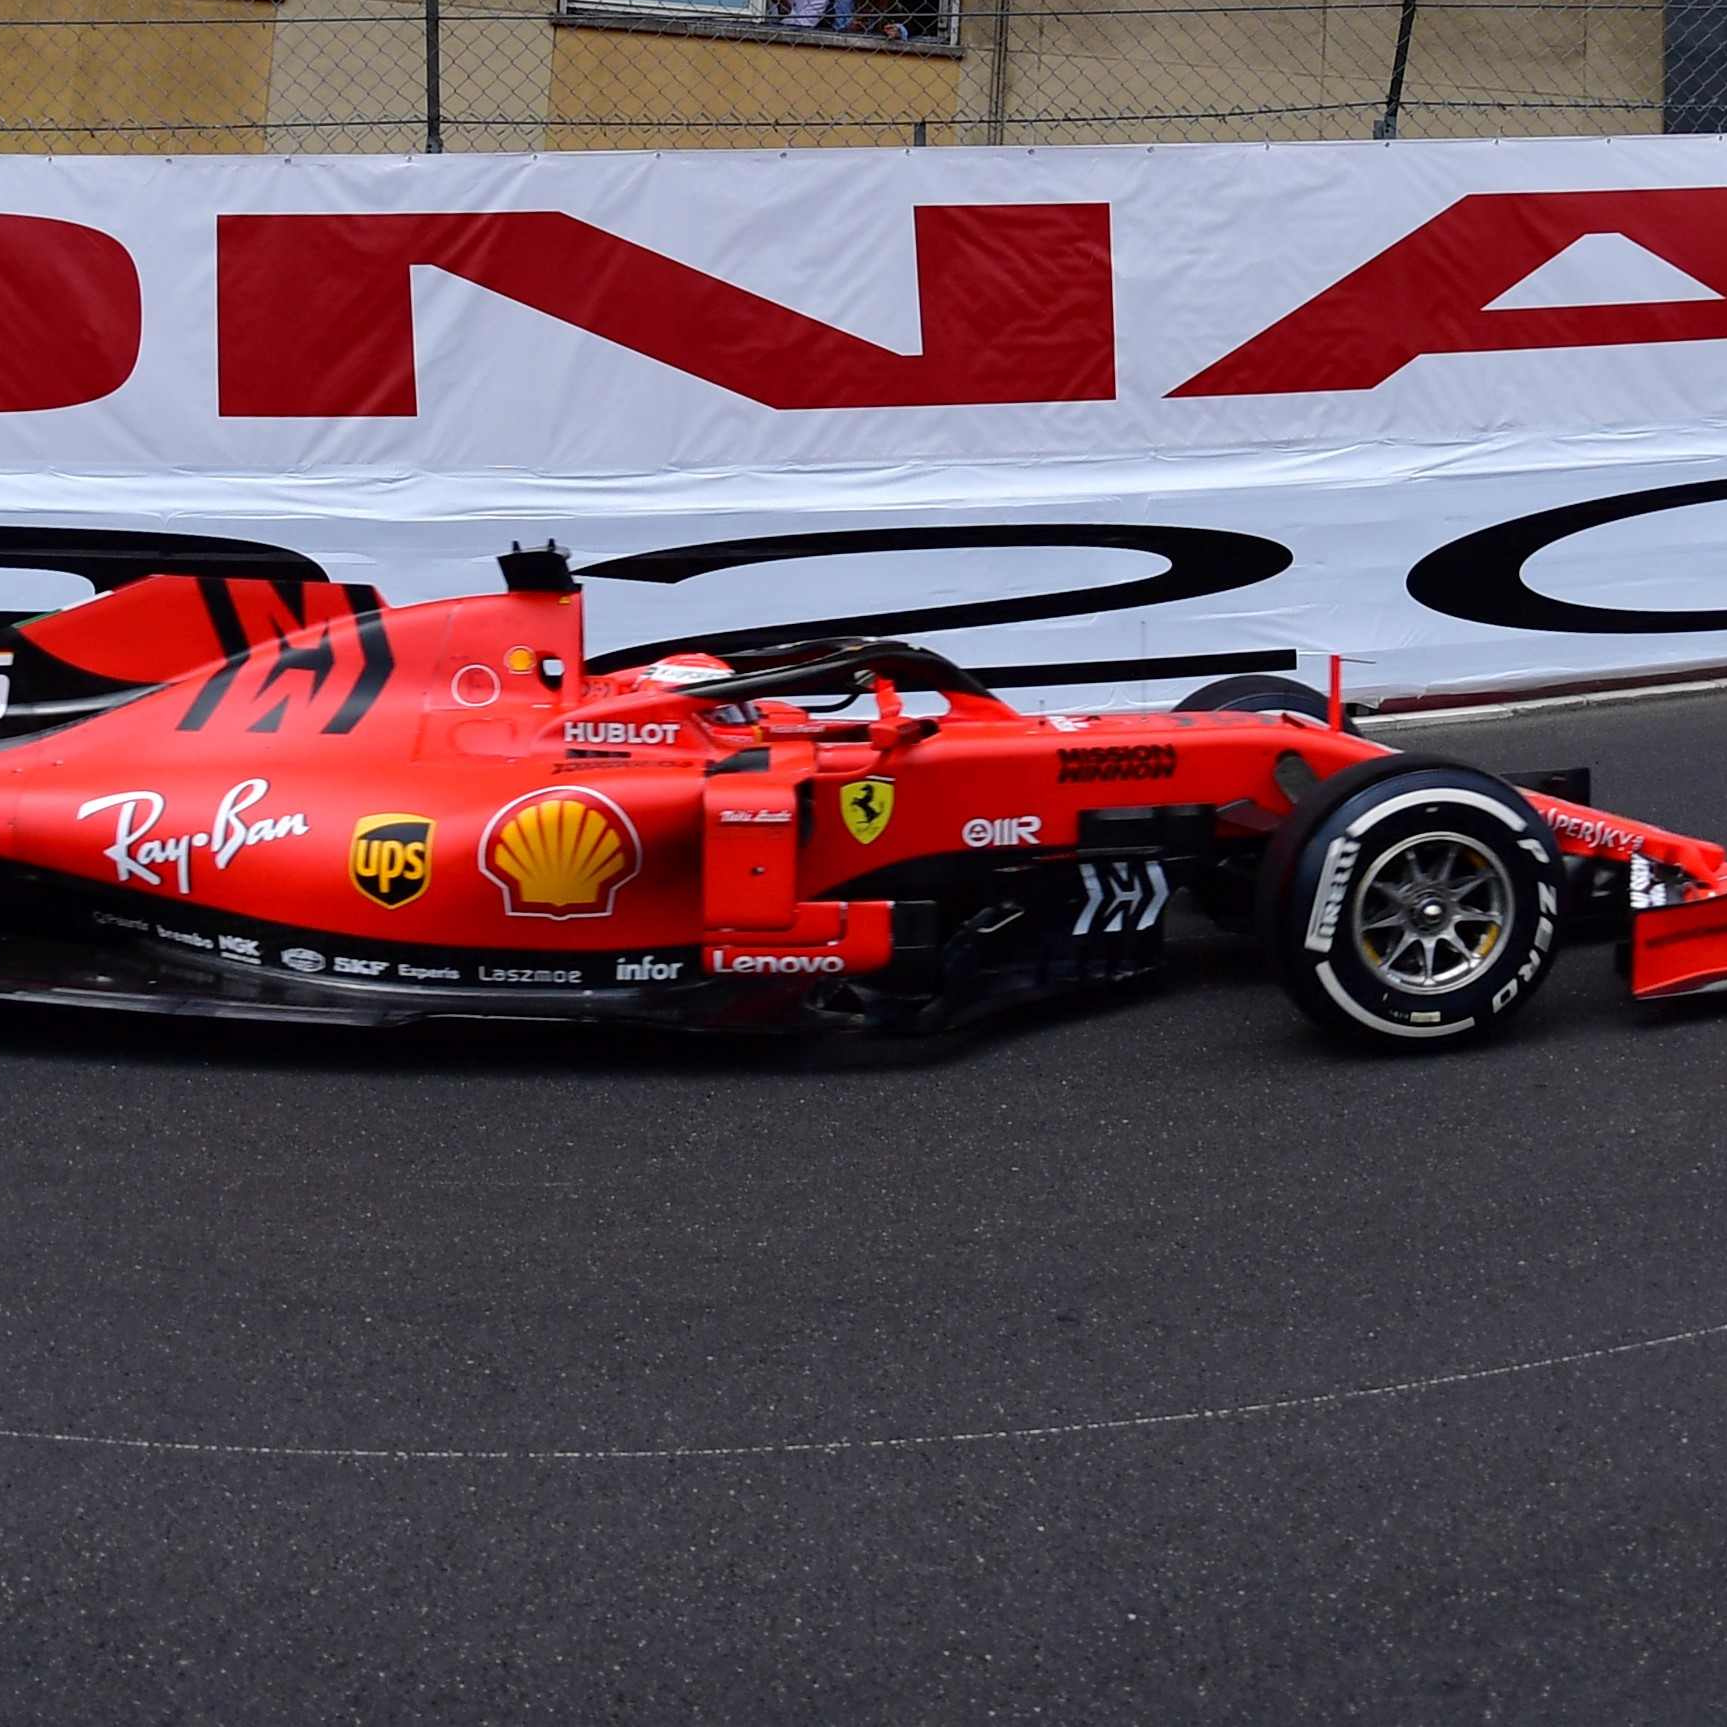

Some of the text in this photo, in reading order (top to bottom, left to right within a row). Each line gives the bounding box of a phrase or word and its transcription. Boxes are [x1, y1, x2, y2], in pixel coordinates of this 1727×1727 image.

[563, 721, 680, 745] HUBLOT
[356, 839, 426, 894] ups
[218, 934, 261, 956] NGK
[333, 955, 390, 976] SKF
[616, 955, 683, 981] infor
[712, 949, 845, 974] Lenovo
